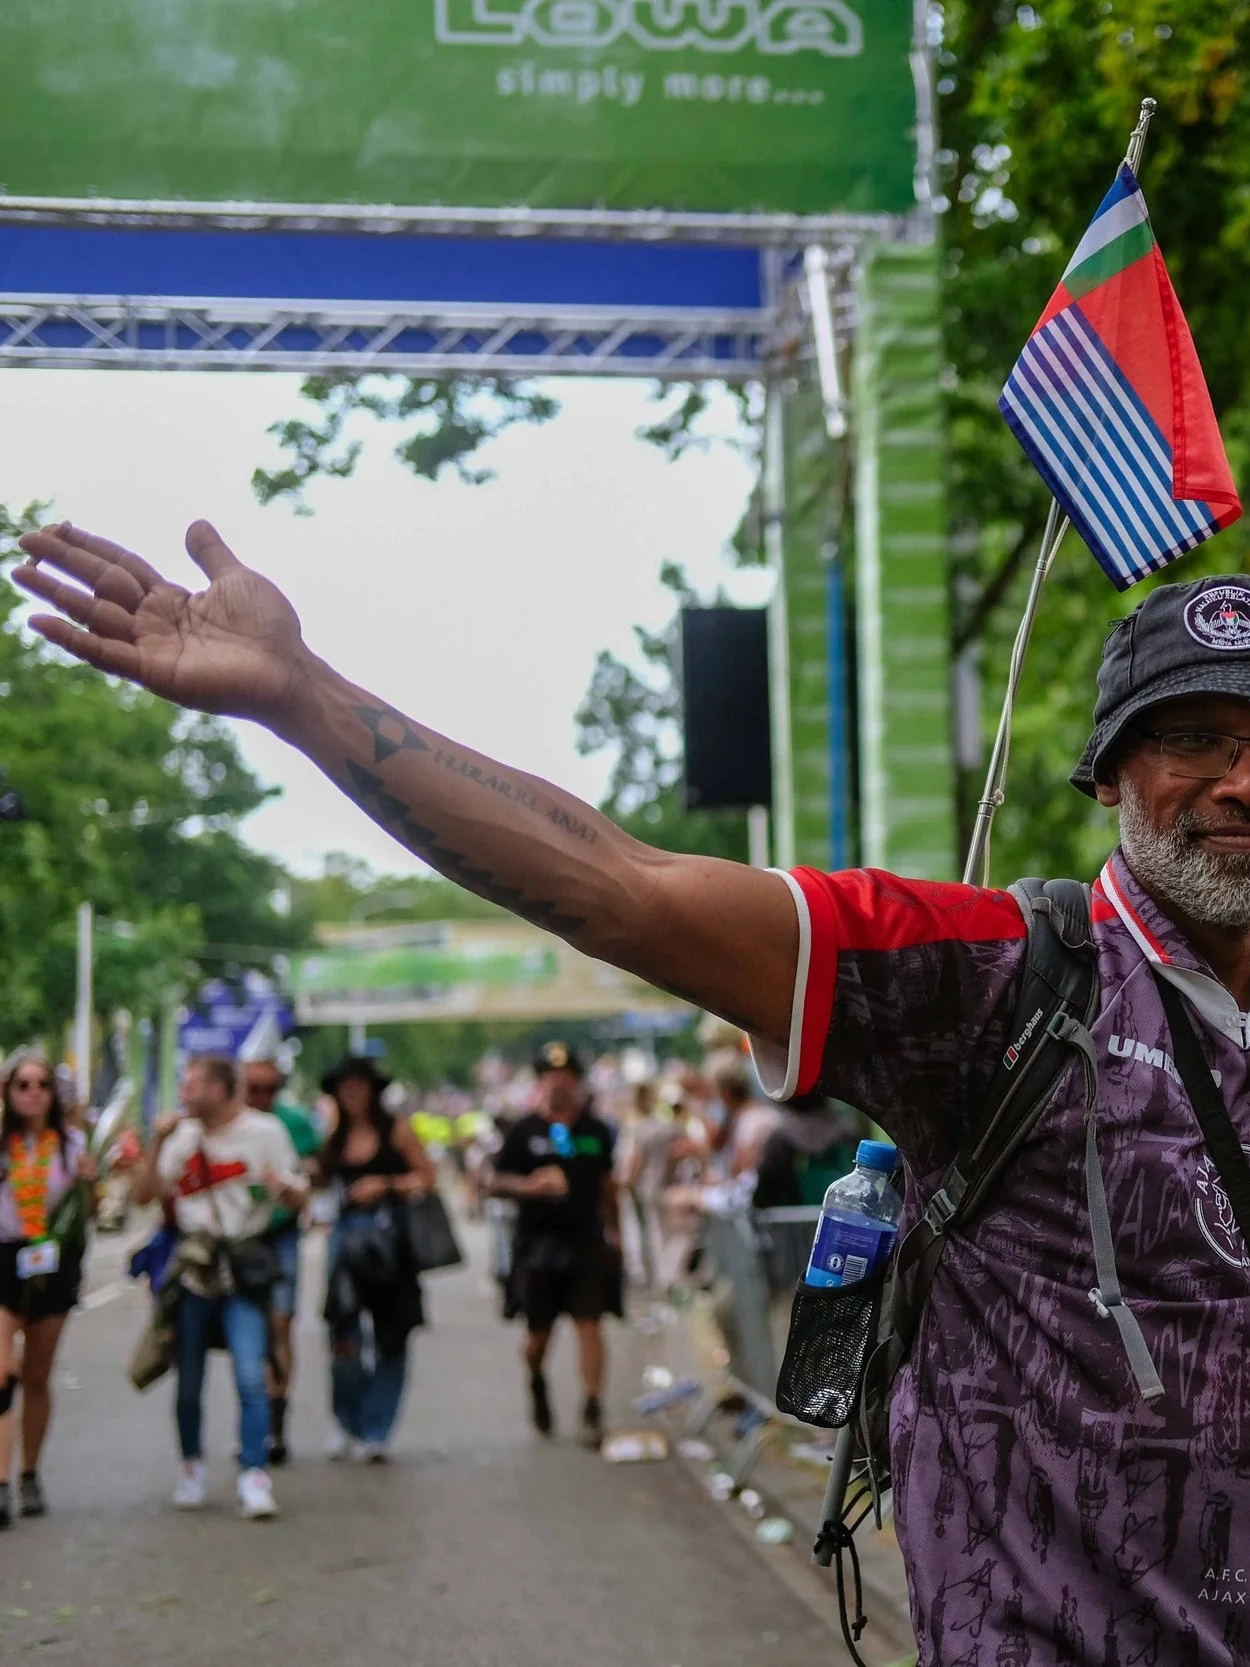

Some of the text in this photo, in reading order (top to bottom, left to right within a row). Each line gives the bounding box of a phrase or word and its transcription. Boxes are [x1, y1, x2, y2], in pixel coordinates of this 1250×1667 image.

[496, 61, 825, 105] simply more...
[1013, 1008, 1044, 1051] berghaus
[1196, 1154, 1216, 1195] AJA
[1204, 1568, 1247, 1582] A.F.C.
[1198, 1588, 1247, 1605] AJAX
